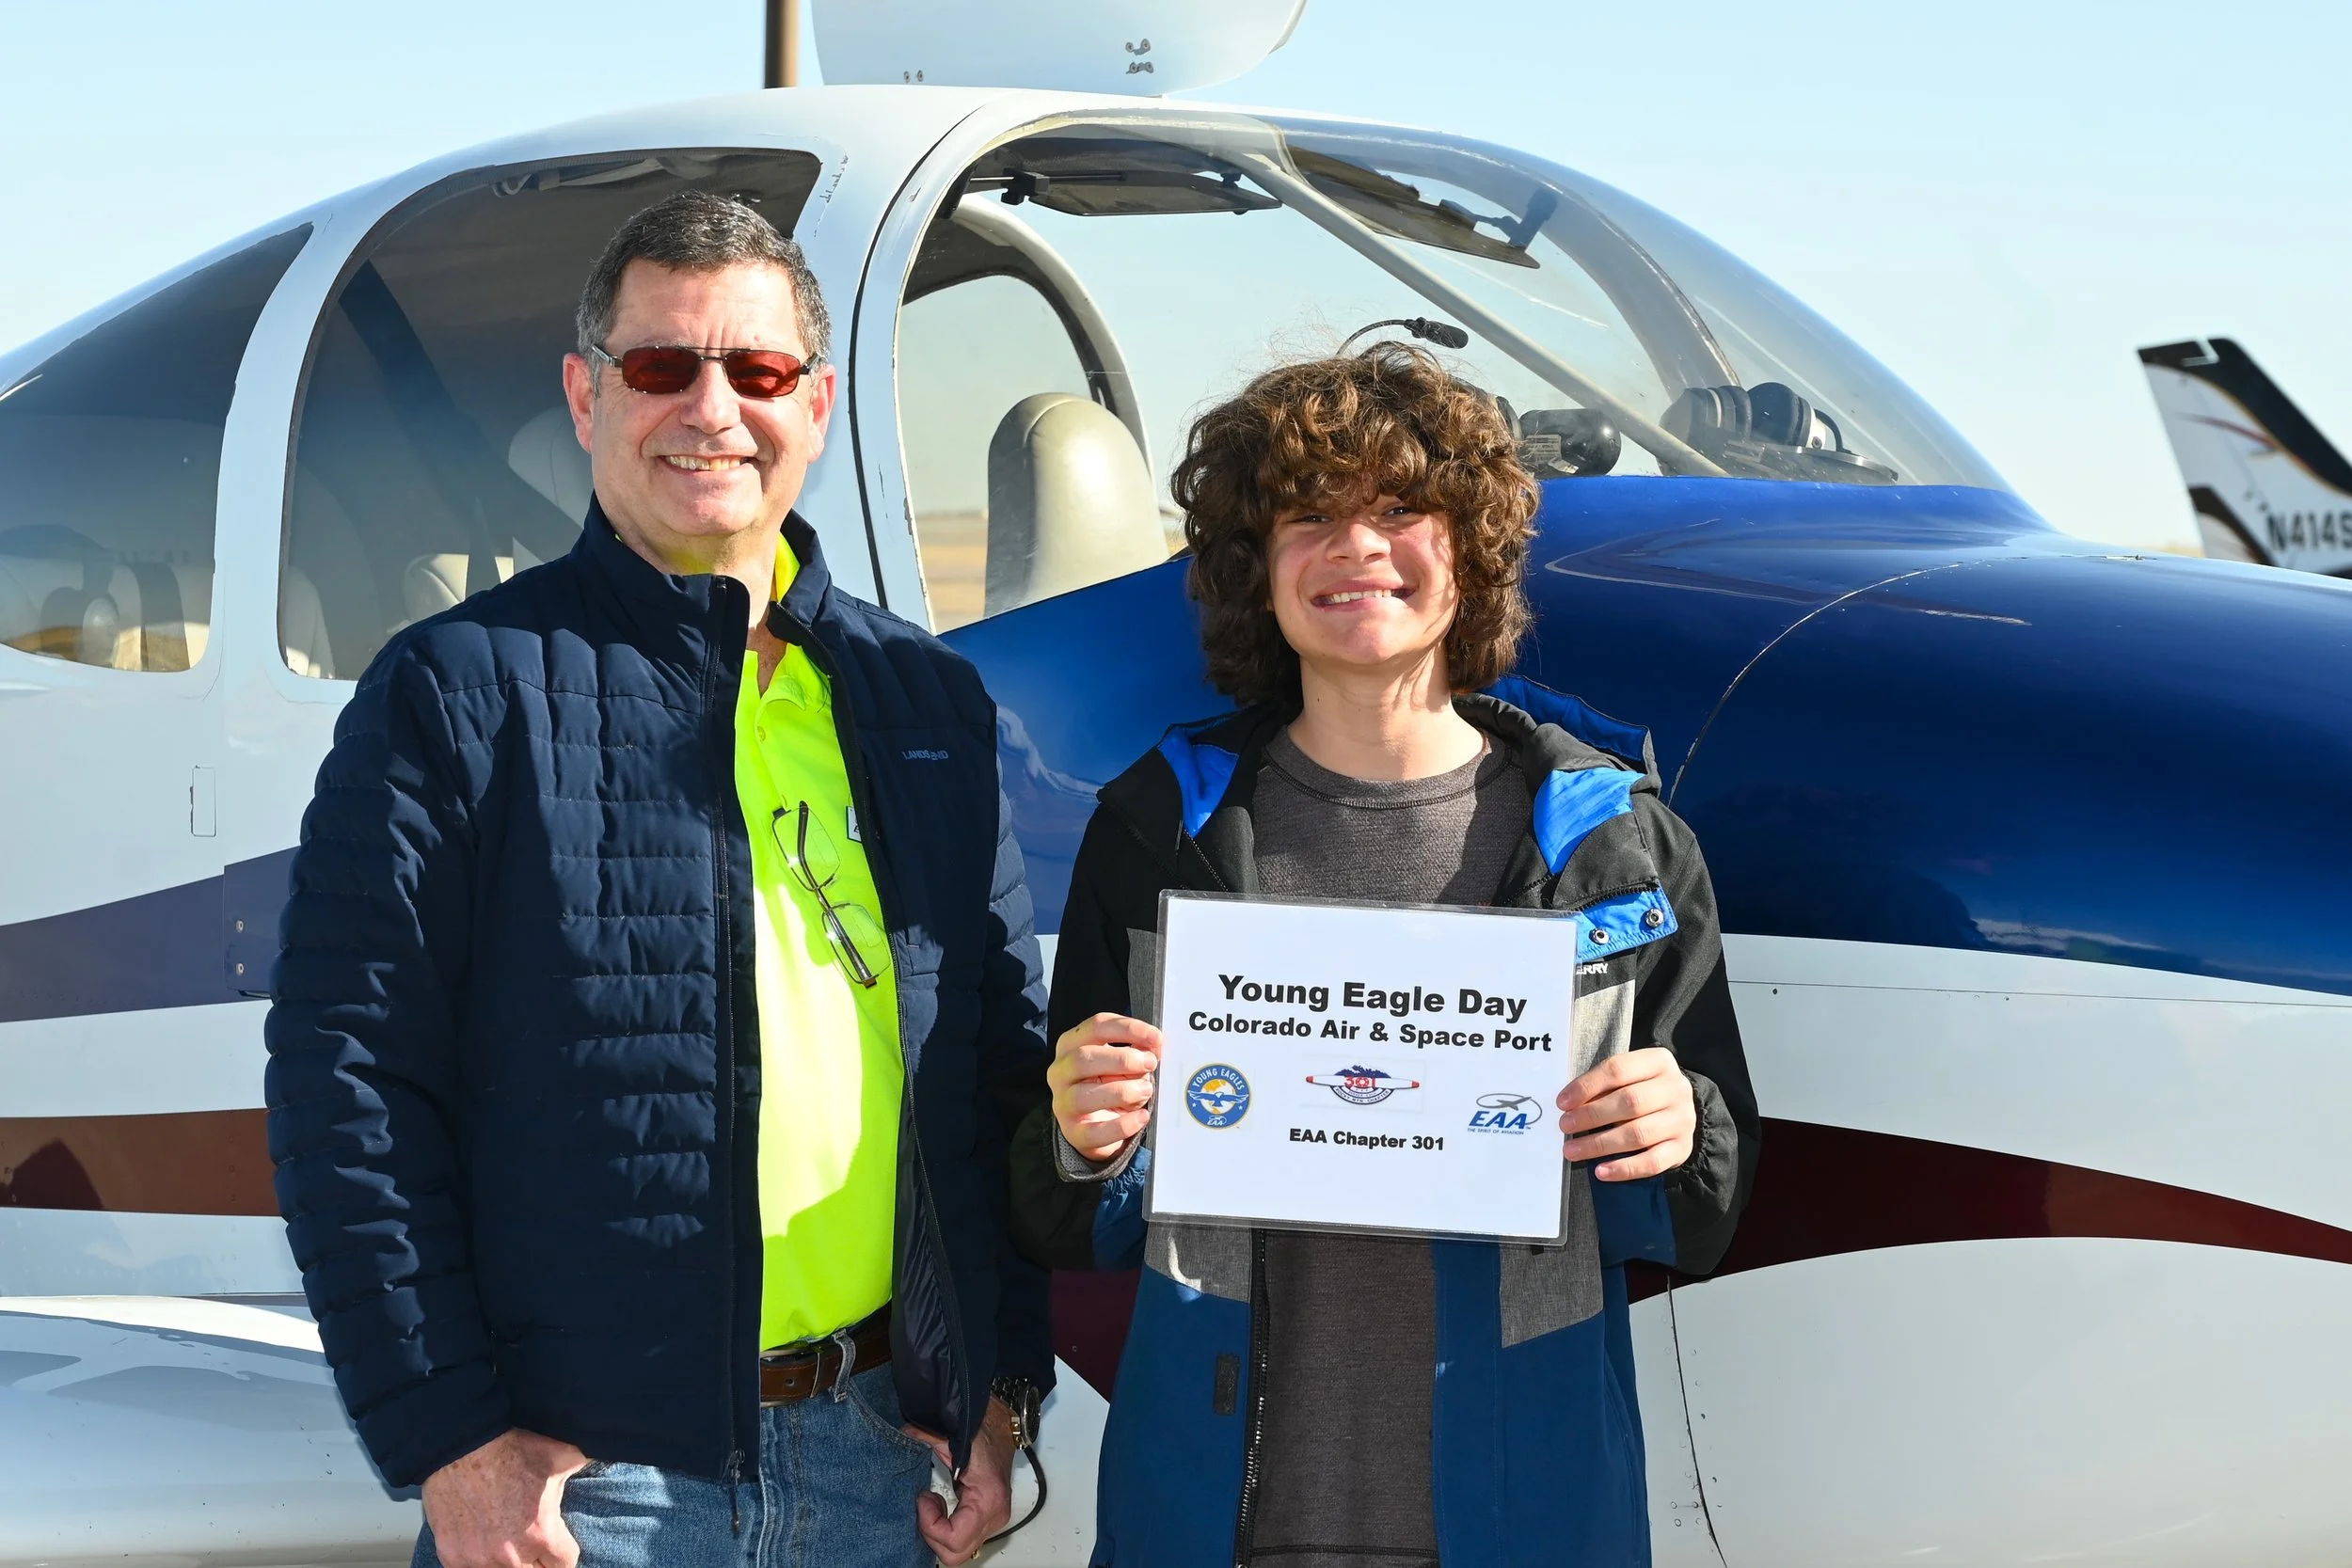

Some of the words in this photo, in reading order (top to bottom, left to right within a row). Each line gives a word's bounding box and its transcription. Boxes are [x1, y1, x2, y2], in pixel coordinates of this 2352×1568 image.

[1217, 974, 1329, 1013] Young
[1343, 981, 1445, 1018] Eagle
[1458, 988, 1528, 1024] Day
[1188, 1011, 1312, 1037] Colorado
[1319, 1019, 1361, 1040] Air
[1369, 1022, 1390, 1042] &
[1399, 1023, 1485, 1050] Space
[1494, 1028, 1552, 1053] Port
[1191, 1068, 1218, 1087] YOUNG
[1220, 1068, 1245, 1091] EAGLES
[1469, 1110, 1527, 1130] EAA
[1289, 1128, 1327, 1144] EAA
[1333, 1130, 1407, 1149] Chapter
[1411, 1135, 1444, 1150] 301
